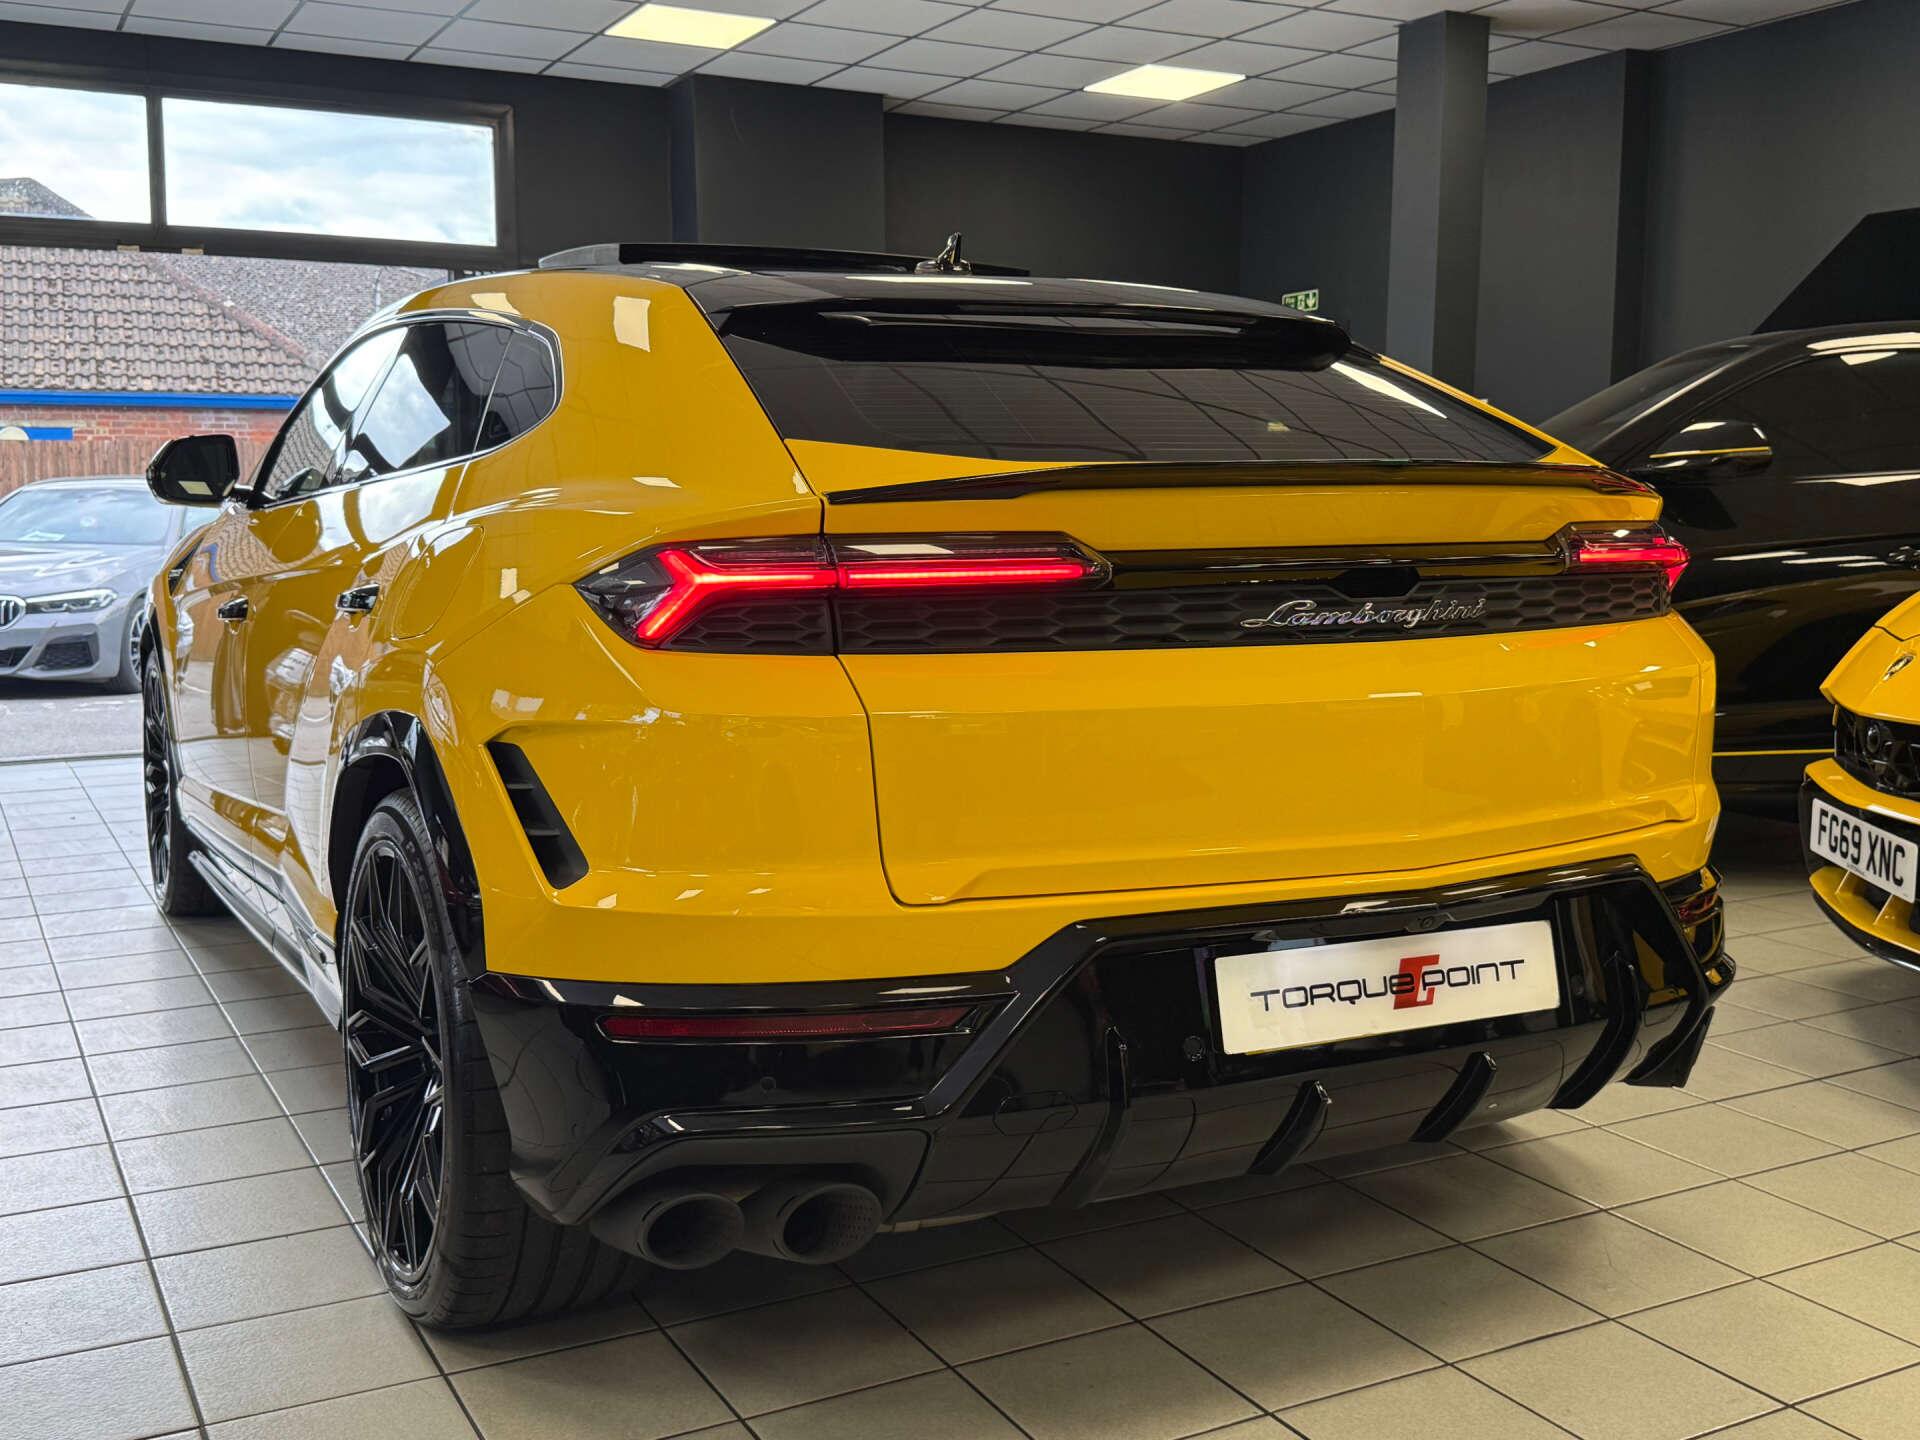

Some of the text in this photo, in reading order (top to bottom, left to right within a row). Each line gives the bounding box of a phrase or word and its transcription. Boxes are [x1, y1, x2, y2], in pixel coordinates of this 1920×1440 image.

[1240, 598, 1487, 629] Lamborghini
[1818, 808, 1906, 887] FG69 XNC
